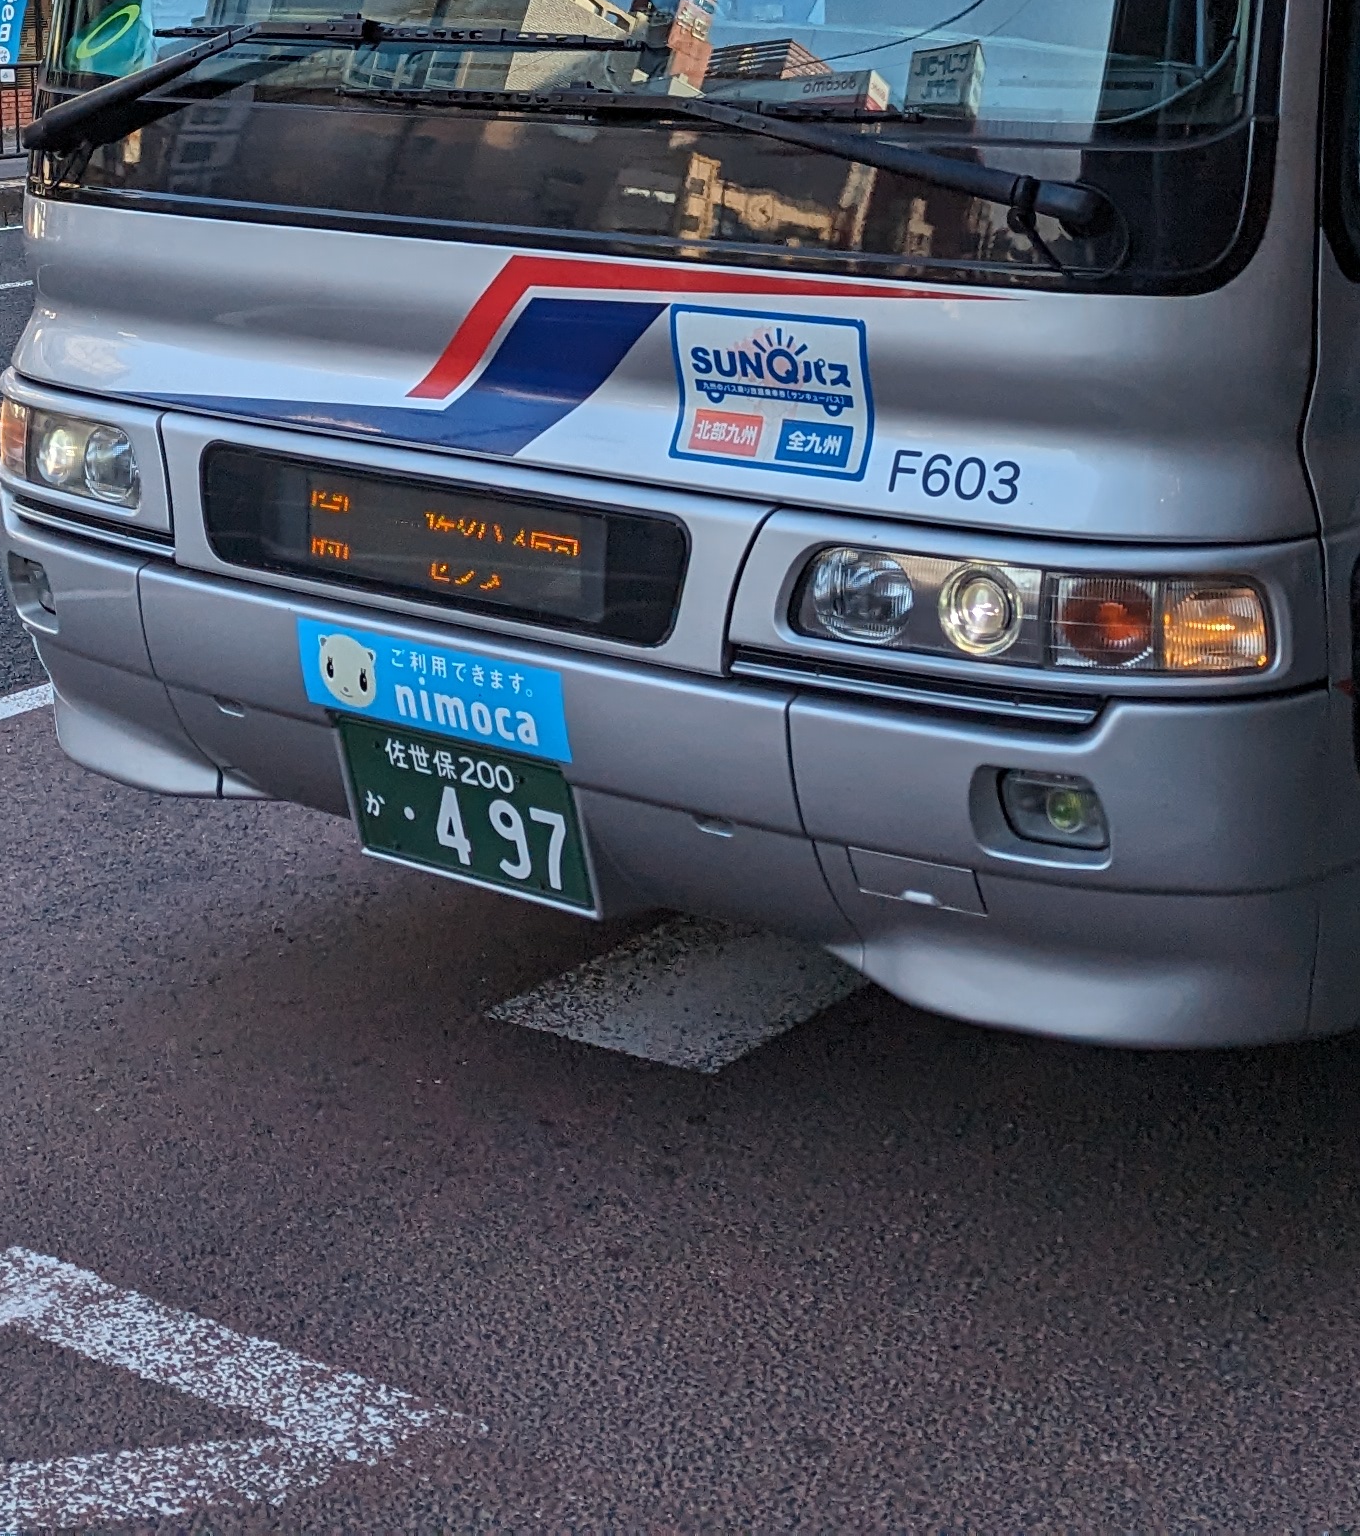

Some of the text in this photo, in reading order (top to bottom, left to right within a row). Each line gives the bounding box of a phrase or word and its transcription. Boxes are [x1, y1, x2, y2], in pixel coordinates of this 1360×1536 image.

[694, 419, 759, 447] 北部九州
[785, 430, 843, 457] 全九州
[887, 449, 1021, 505] F603
[391, 648, 533, 698] ご利用できます。
[394, 676, 539, 747] nimoca
[364, 789, 386, 817] か
